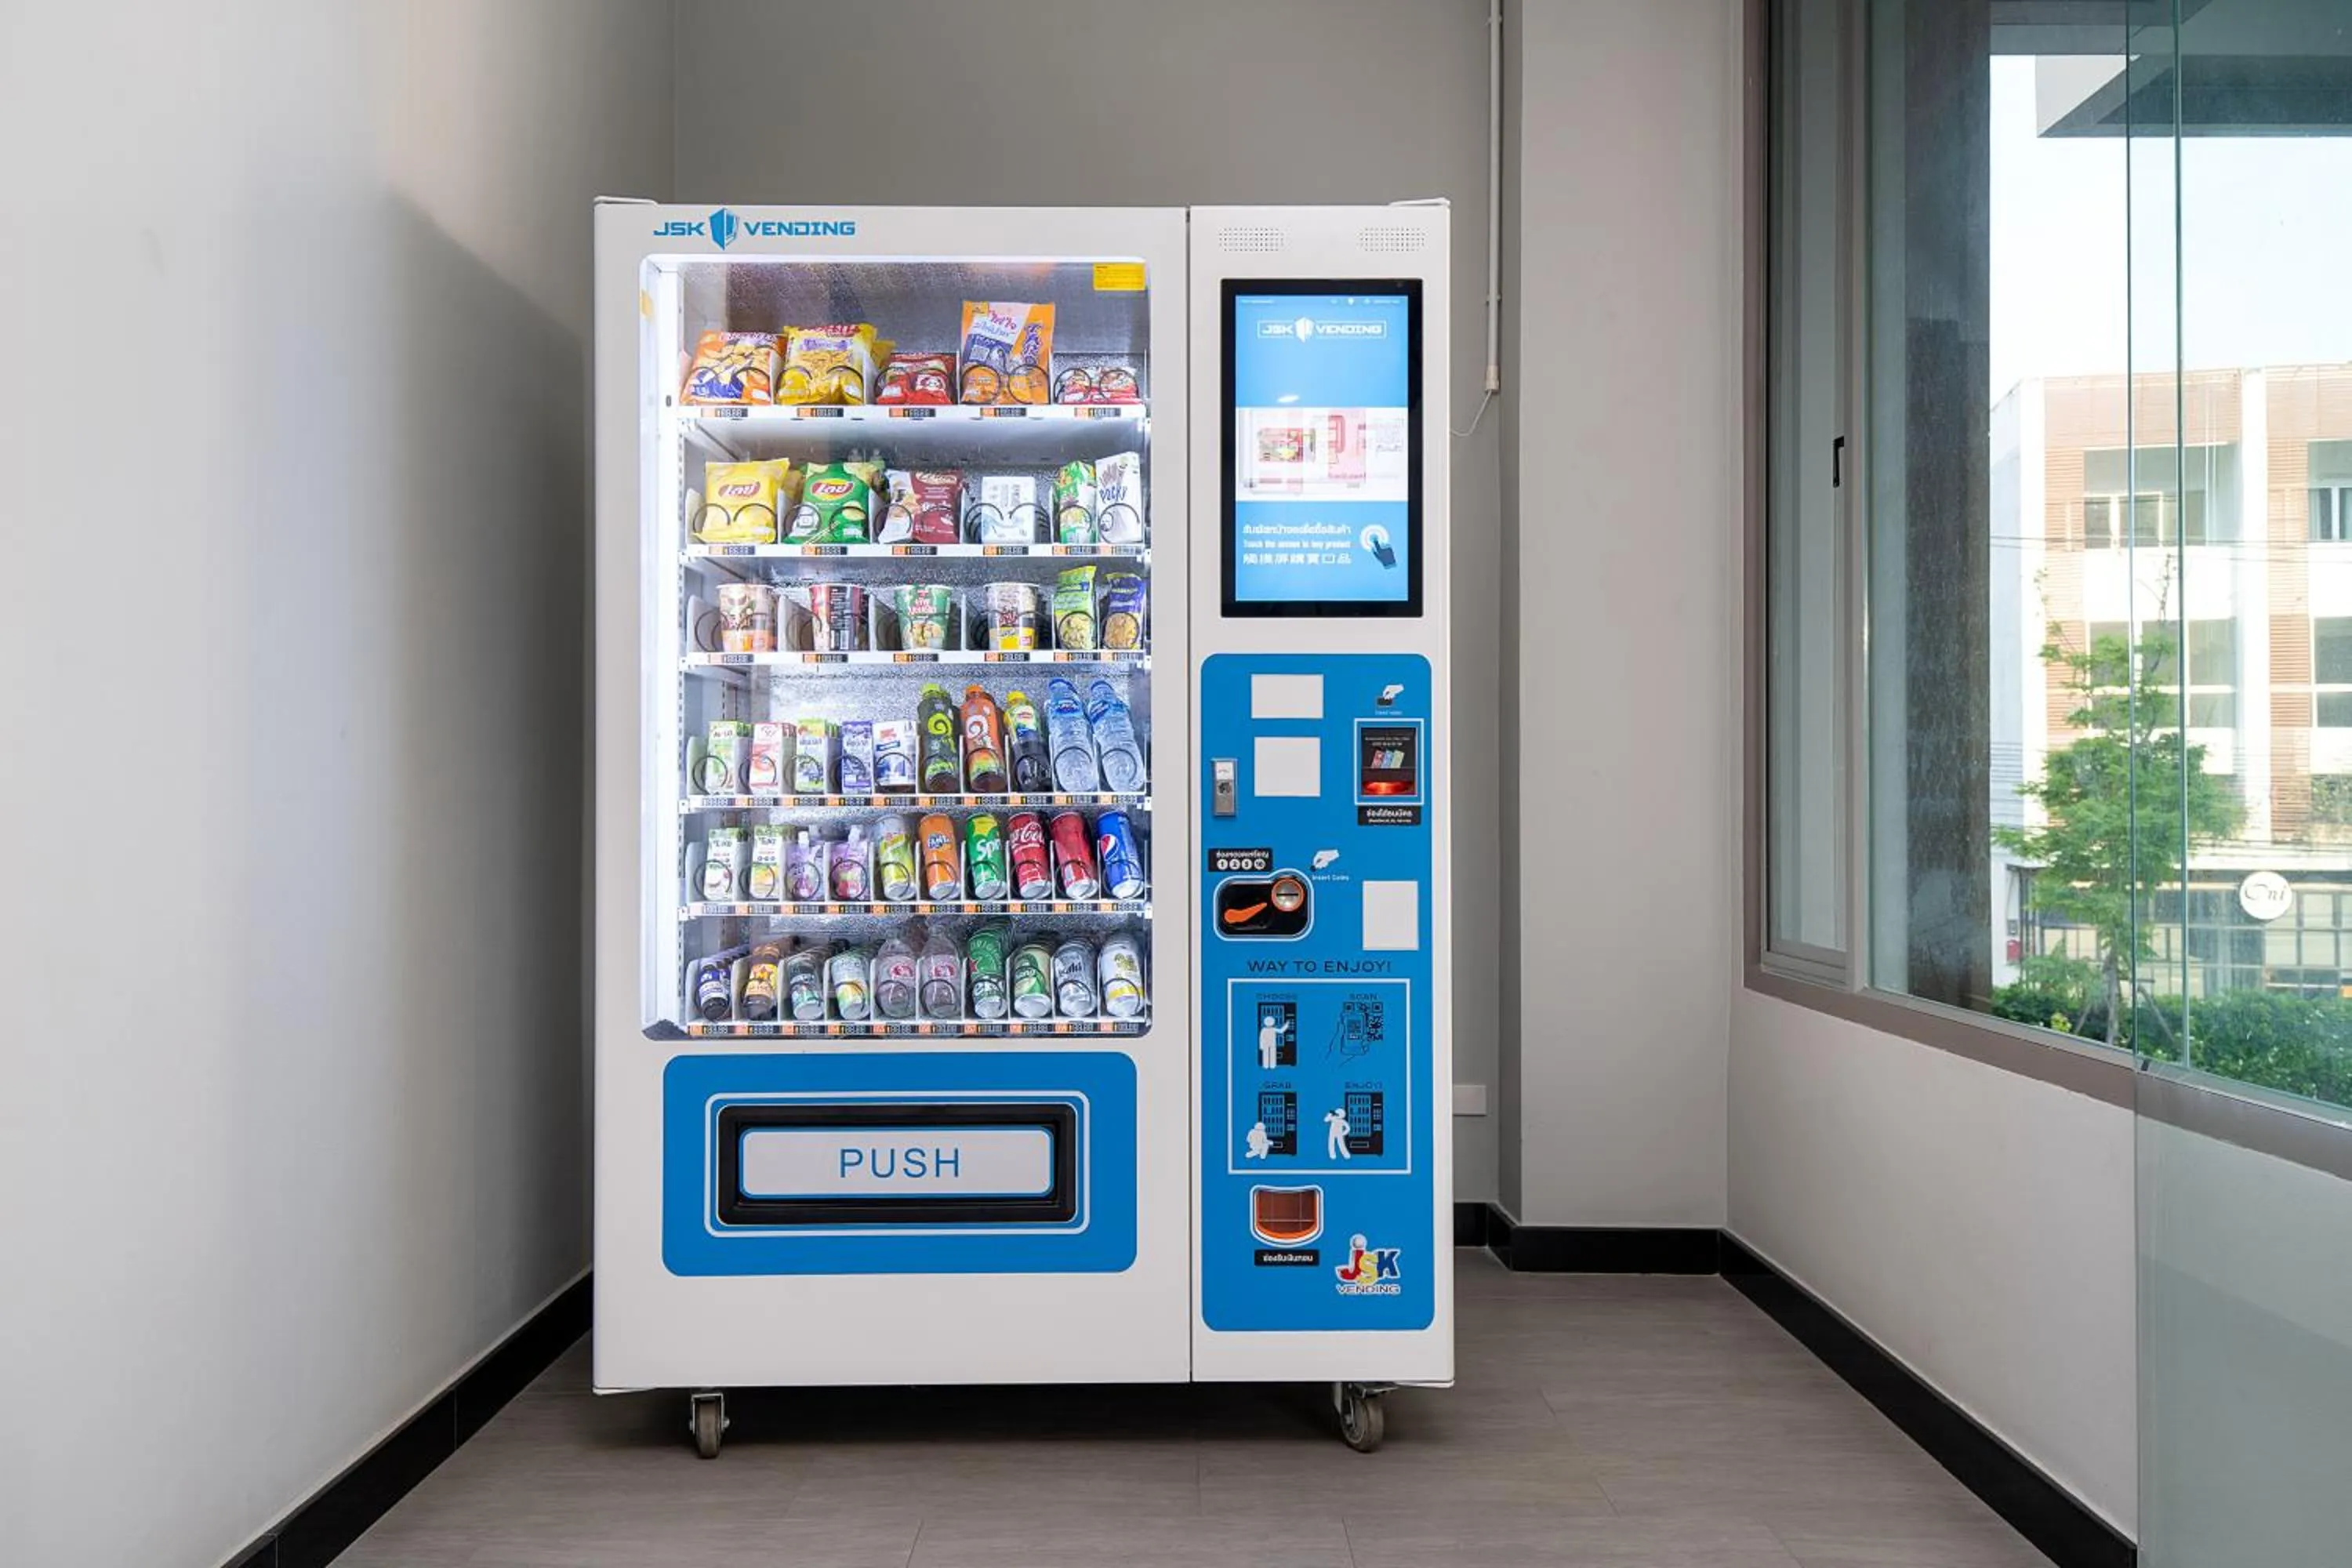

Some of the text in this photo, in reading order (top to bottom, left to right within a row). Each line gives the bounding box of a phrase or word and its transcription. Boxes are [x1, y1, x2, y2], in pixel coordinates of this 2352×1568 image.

[653, 221, 856, 236] JSK VENDING
[1261, 324, 1383, 334] JSK VENDING
[977, 838, 1001, 862] Spr
[1247, 960, 1392, 973] WAY TO ENJOY!
[840, 1148, 960, 1178] PUSH
[1335, 1234, 1401, 1285] JSK
[1337, 1285, 1400, 1294] VENDING
